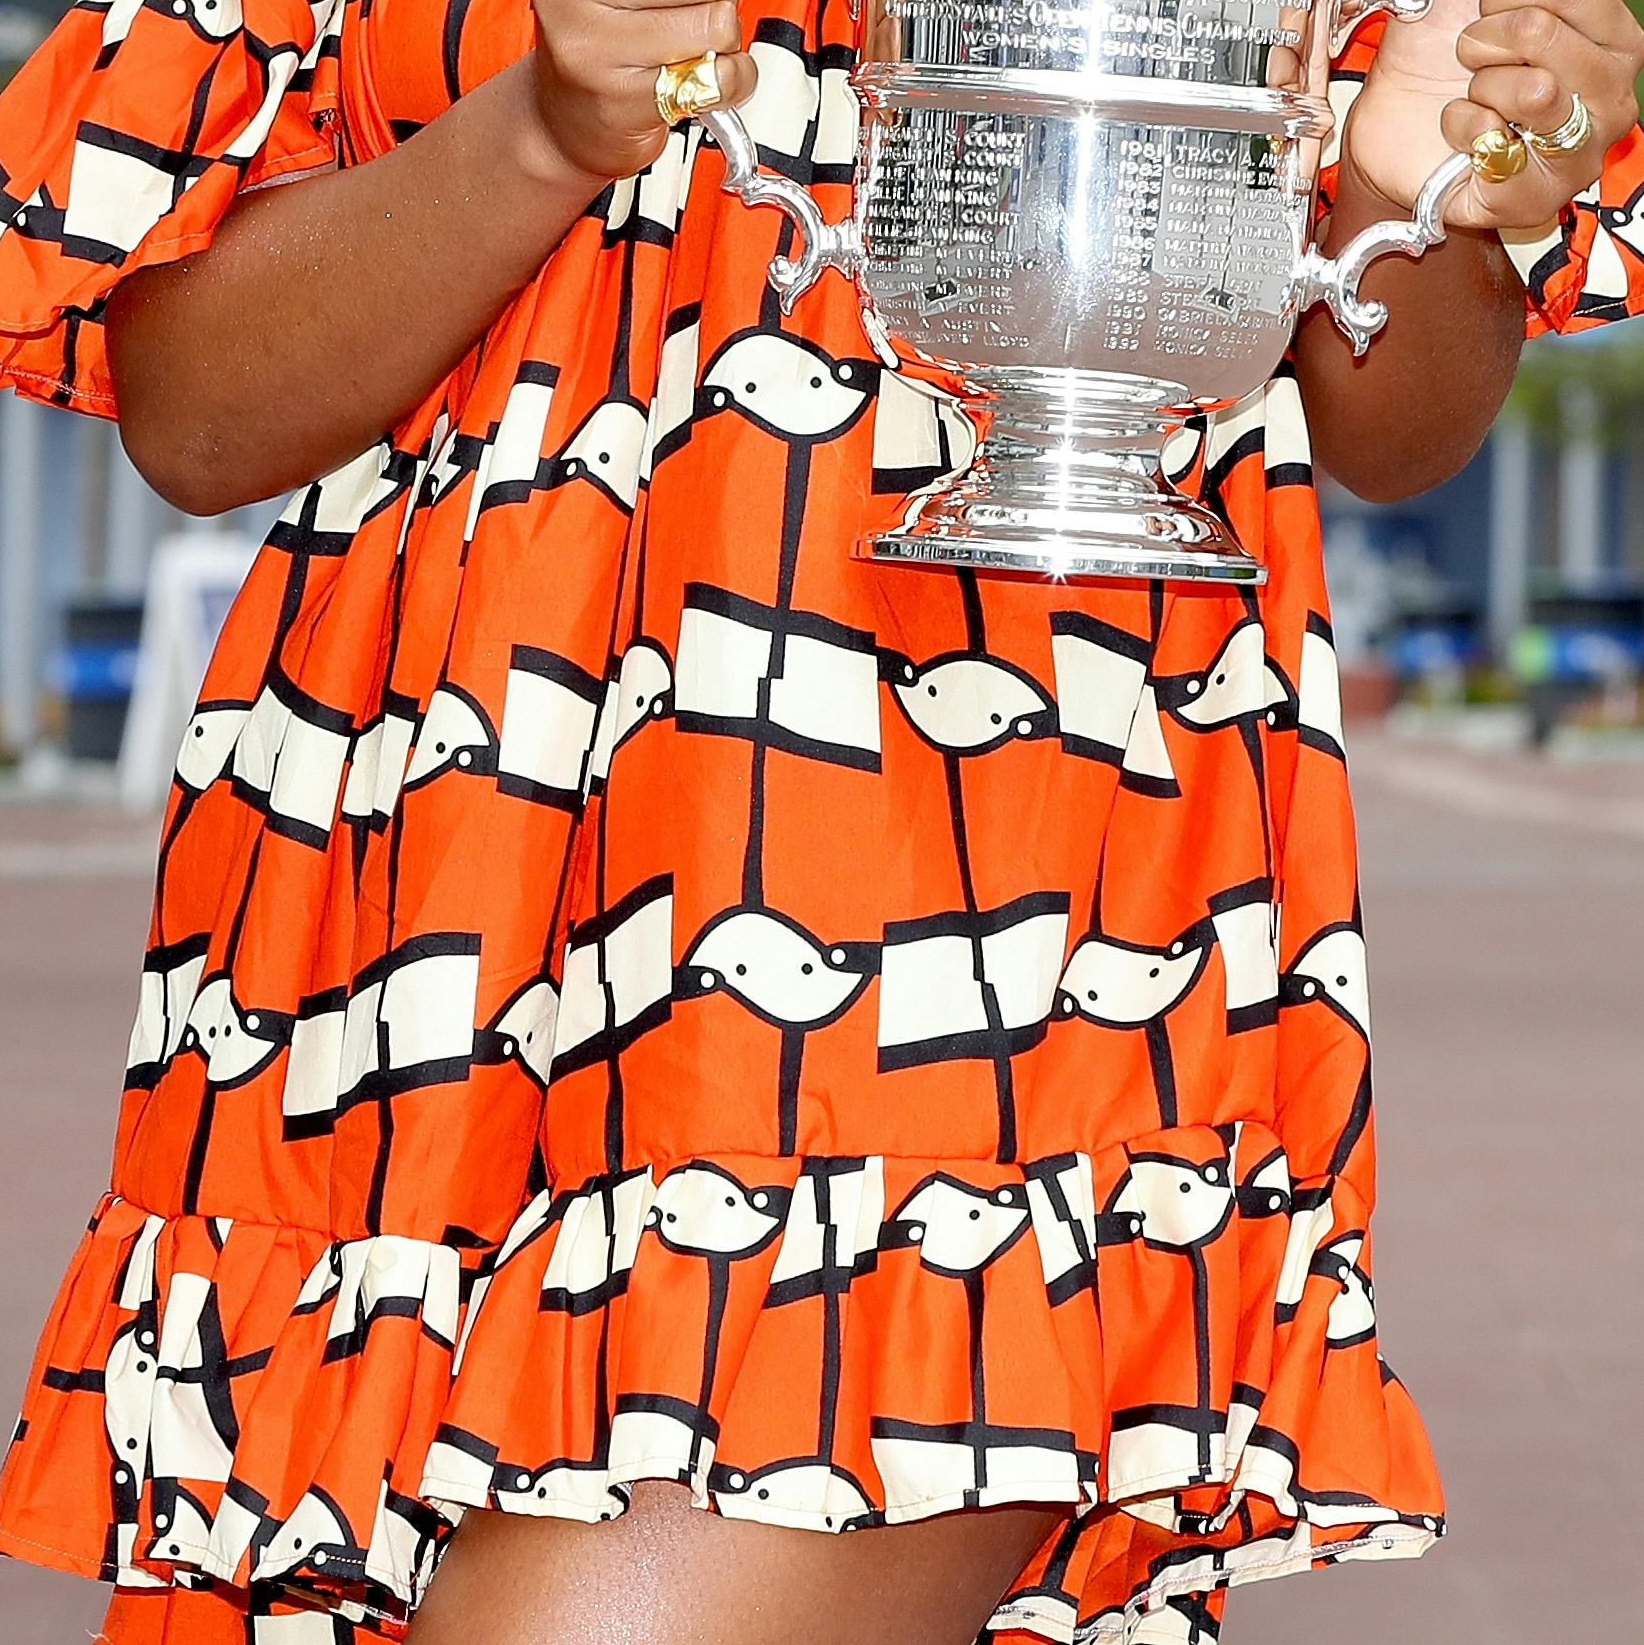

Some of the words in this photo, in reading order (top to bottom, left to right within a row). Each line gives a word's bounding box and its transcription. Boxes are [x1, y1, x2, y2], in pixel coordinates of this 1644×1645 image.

[961, 30, 1089, 56] WOMEN'S
[1101, 39, 1216, 65] SINGLES
[963, 131, 1026, 150] COURT
[963, 150, 1024, 168] COURT
[1120, 140, 1162, 156] 1981
[1175, 144, 1238, 164] TRACY
[1118, 159, 1163, 177] 1982
[954, 170, 999, 186] KING
[1117, 178, 1161, 195] 1983
[954, 189, 997, 206] KING
[961, 209, 1021, 226] COURT
[952, 227, 994, 244] KING
[1112, 234, 1156, 251] 1986
[1106, 304, 1147, 321] 1990
